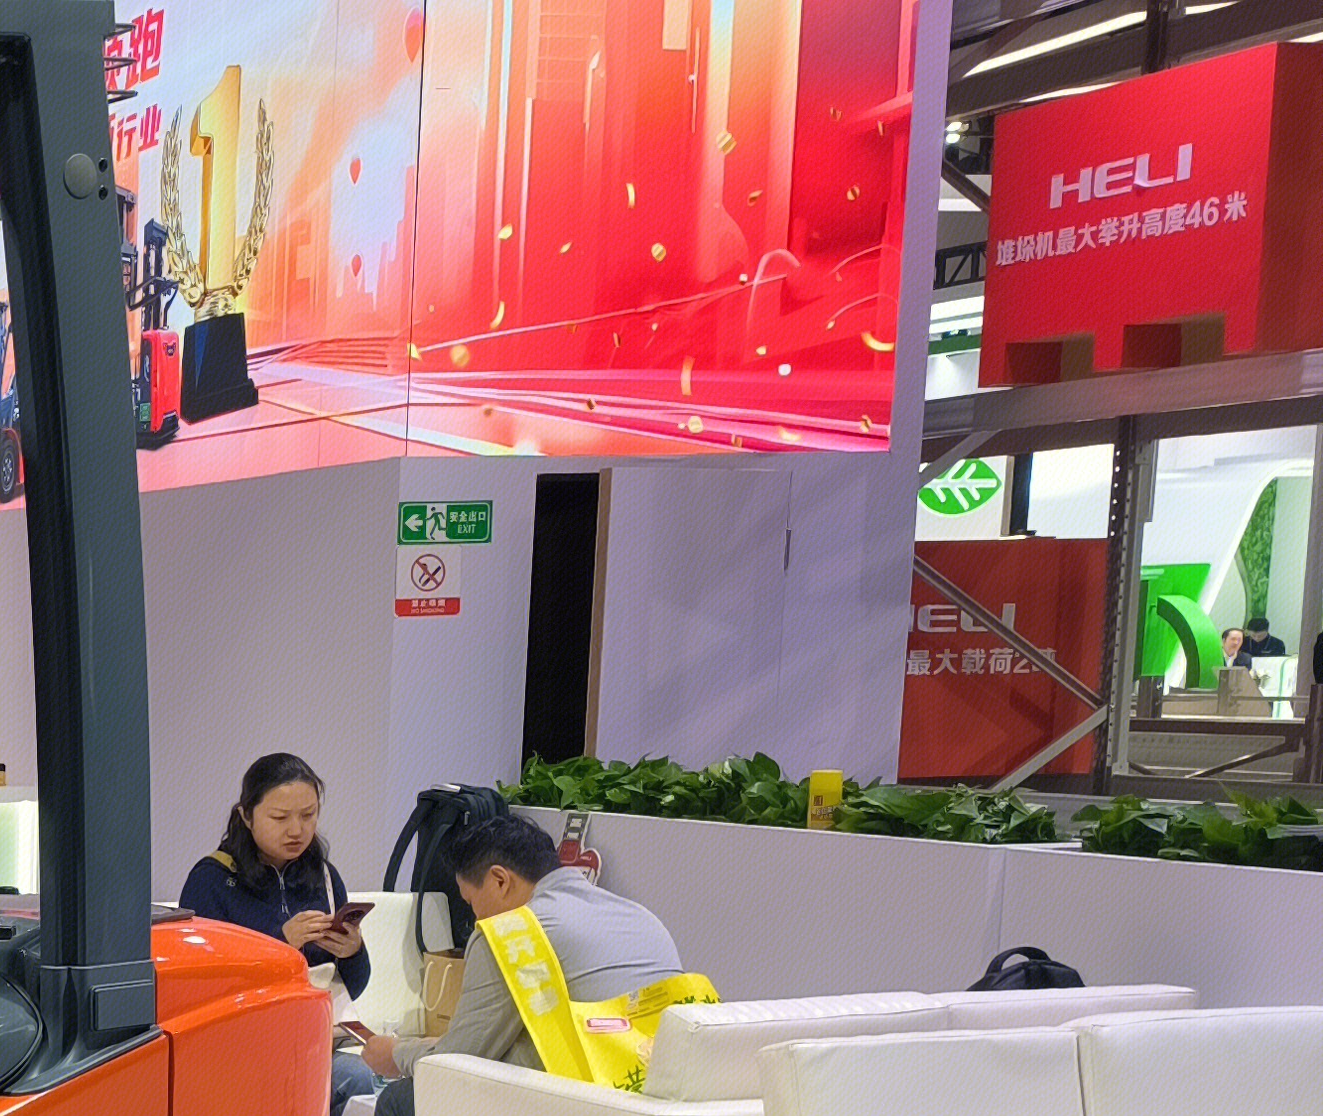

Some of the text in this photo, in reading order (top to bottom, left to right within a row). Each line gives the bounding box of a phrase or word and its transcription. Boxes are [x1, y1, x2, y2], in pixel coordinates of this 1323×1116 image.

[108, 103, 162, 164] 行业
[1049, 142, 1193, 210] HELI
[449, 511, 487, 523] 安全出口
[457, 524, 477, 534] EXIT
[909, 602, 1016, 633] ELI
